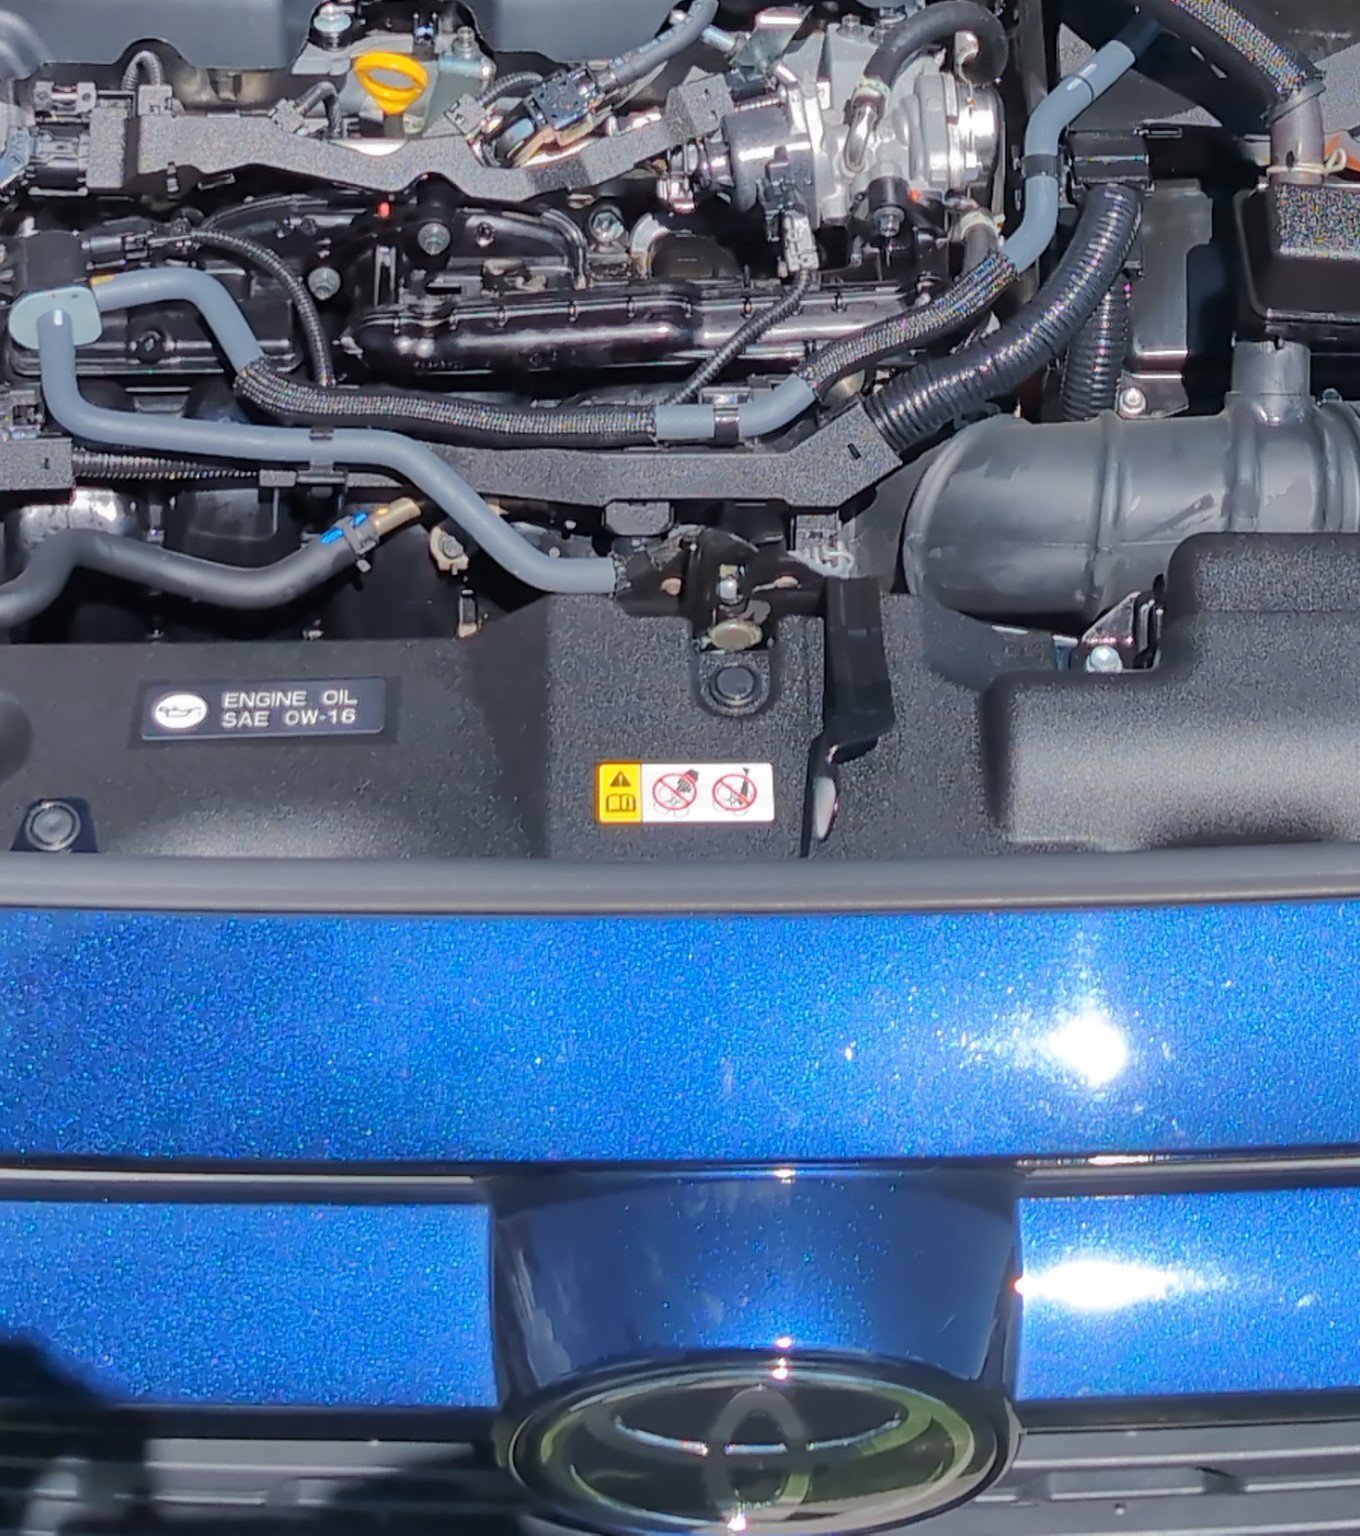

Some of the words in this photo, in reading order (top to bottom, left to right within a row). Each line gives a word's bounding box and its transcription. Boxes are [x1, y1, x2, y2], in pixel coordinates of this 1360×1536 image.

[222, 690, 308, 708] ENGINE
[322, 688, 359, 706] OIL
[221, 710, 269, 728] SAE
[283, 708, 357, 726] 0W-16
